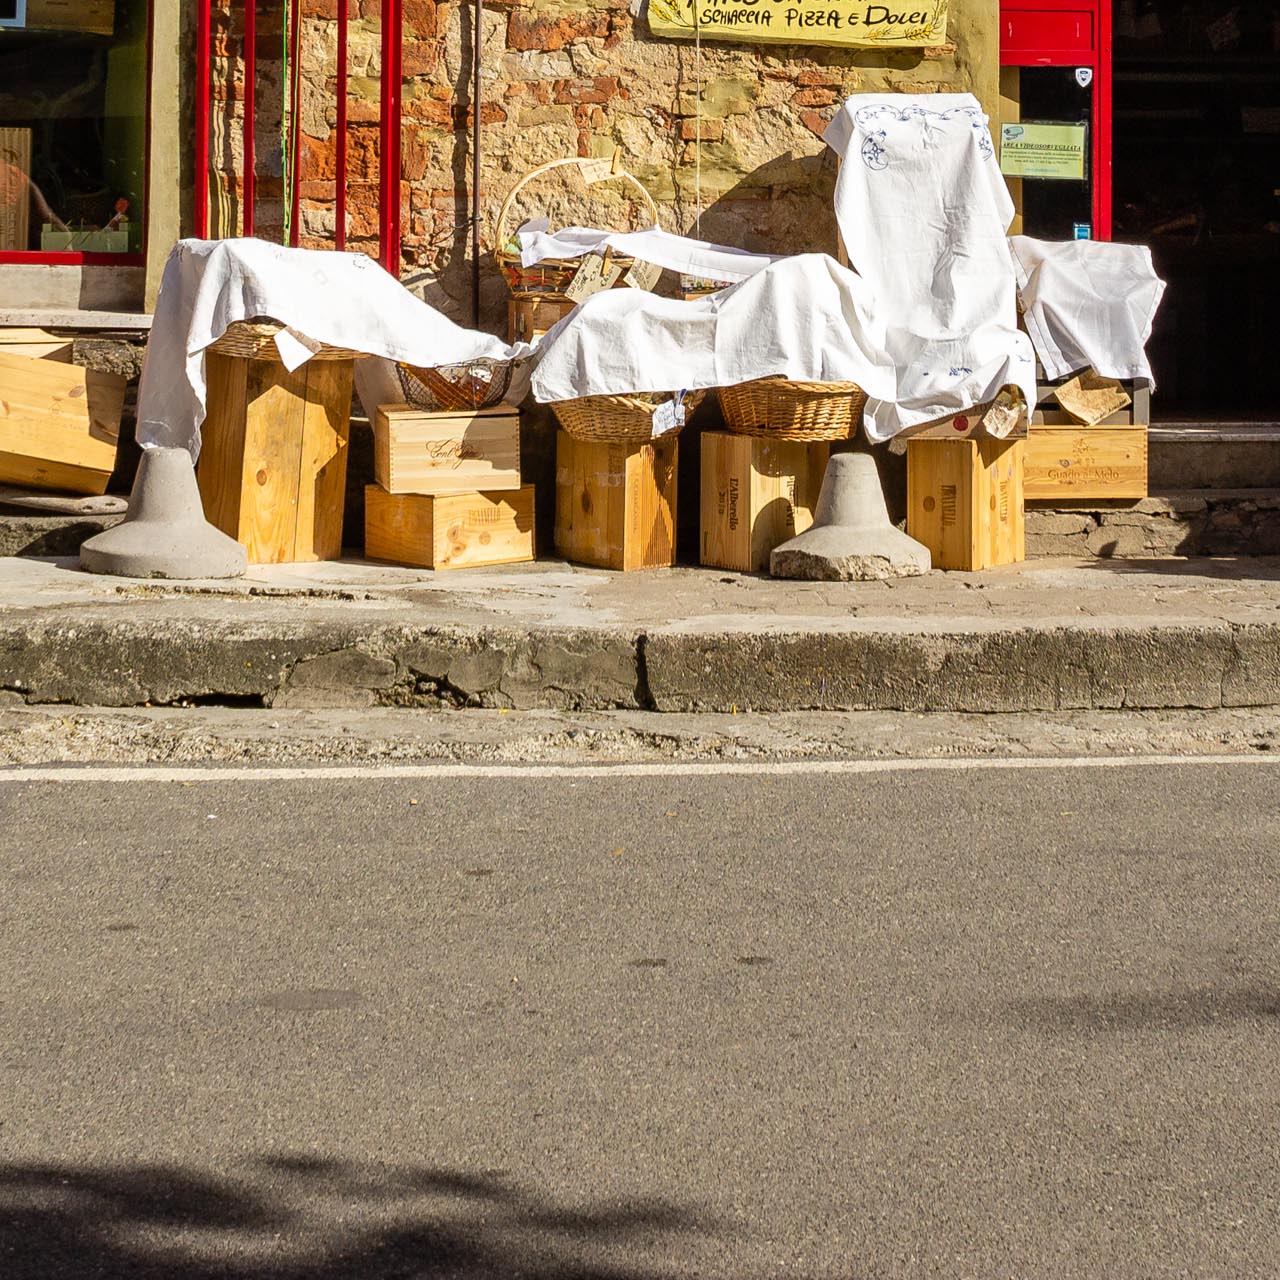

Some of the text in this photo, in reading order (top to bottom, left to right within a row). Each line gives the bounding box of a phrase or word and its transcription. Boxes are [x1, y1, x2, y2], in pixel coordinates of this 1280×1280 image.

[699, 6, 773, 26] SCHIACCIA
[785, 8, 843, 28] PIZZA
[1048, 468, 1120, 480] Guado al Melo
[729, 478, 739, 531] L'Alberello
